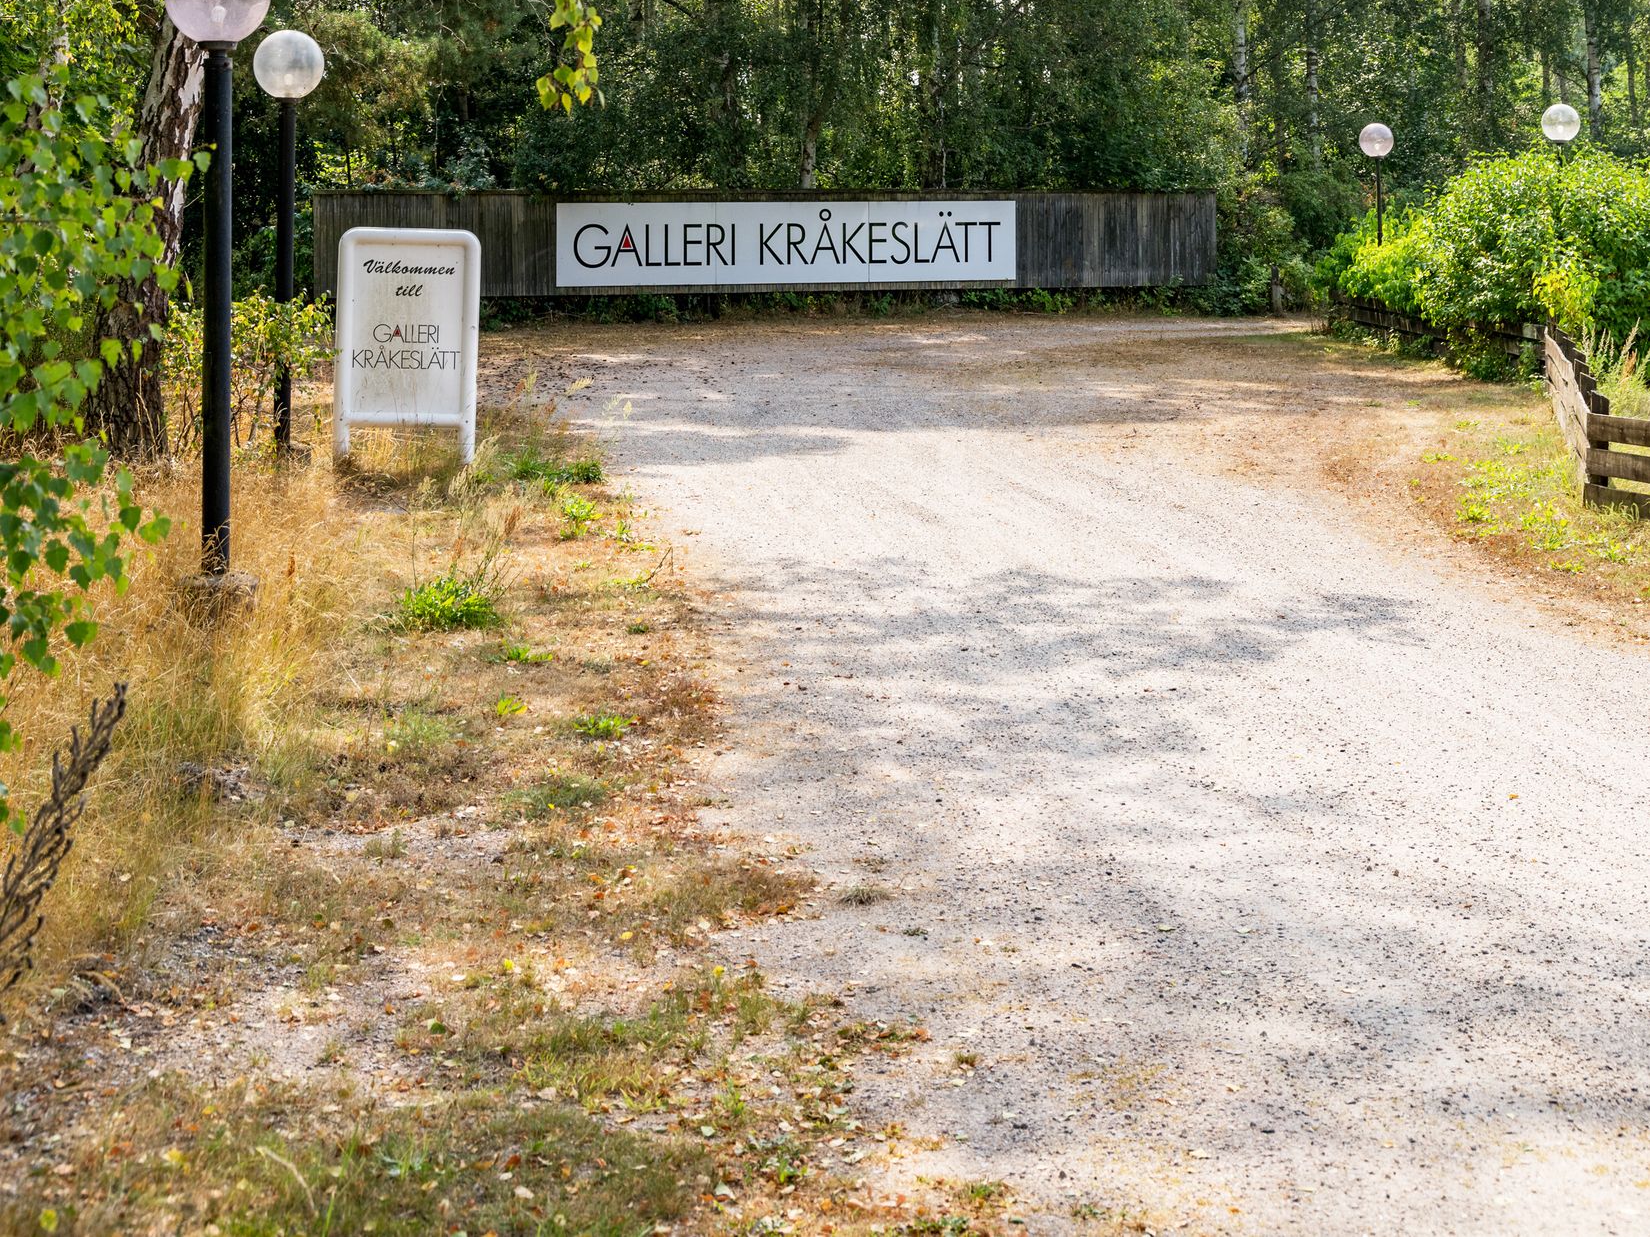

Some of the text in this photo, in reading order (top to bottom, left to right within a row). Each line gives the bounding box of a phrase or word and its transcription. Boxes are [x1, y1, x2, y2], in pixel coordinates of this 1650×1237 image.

[573, 208, 1001, 268] GALLERI KRÅKESLÄTT
[363, 259, 456, 275] Välkommen
[395, 284, 423, 297] till
[373, 323, 440, 343] GALLERI
[352, 345, 461, 370] KRÅKESLÄTT
